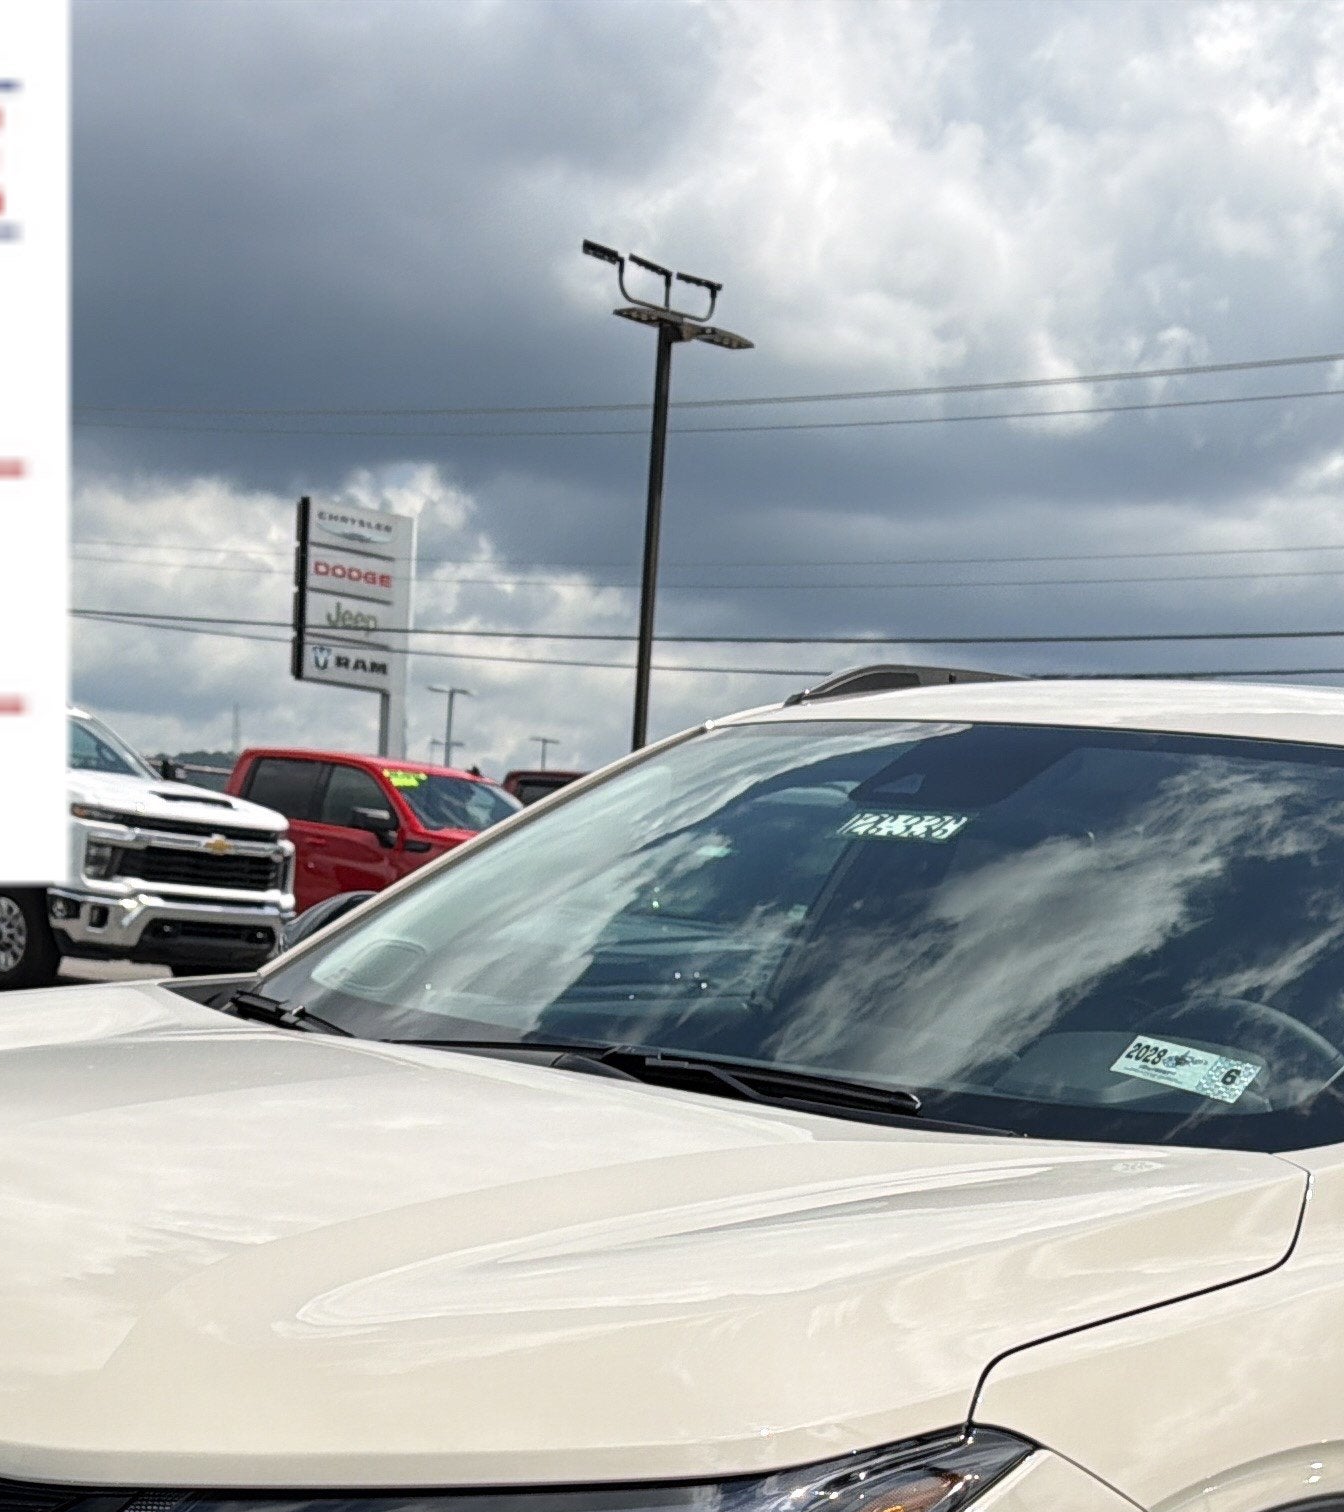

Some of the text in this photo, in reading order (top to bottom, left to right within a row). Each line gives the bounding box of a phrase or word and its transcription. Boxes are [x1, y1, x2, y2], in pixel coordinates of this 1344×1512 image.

[317, 511, 393, 533] CHRYSLER
[313, 560, 393, 588] DODGE
[326, 600, 378, 638] Jeep
[335, 655, 388, 674] RAM
[1125, 1042, 1168, 1066] 2028
[1220, 1068, 1242, 1086] 6
